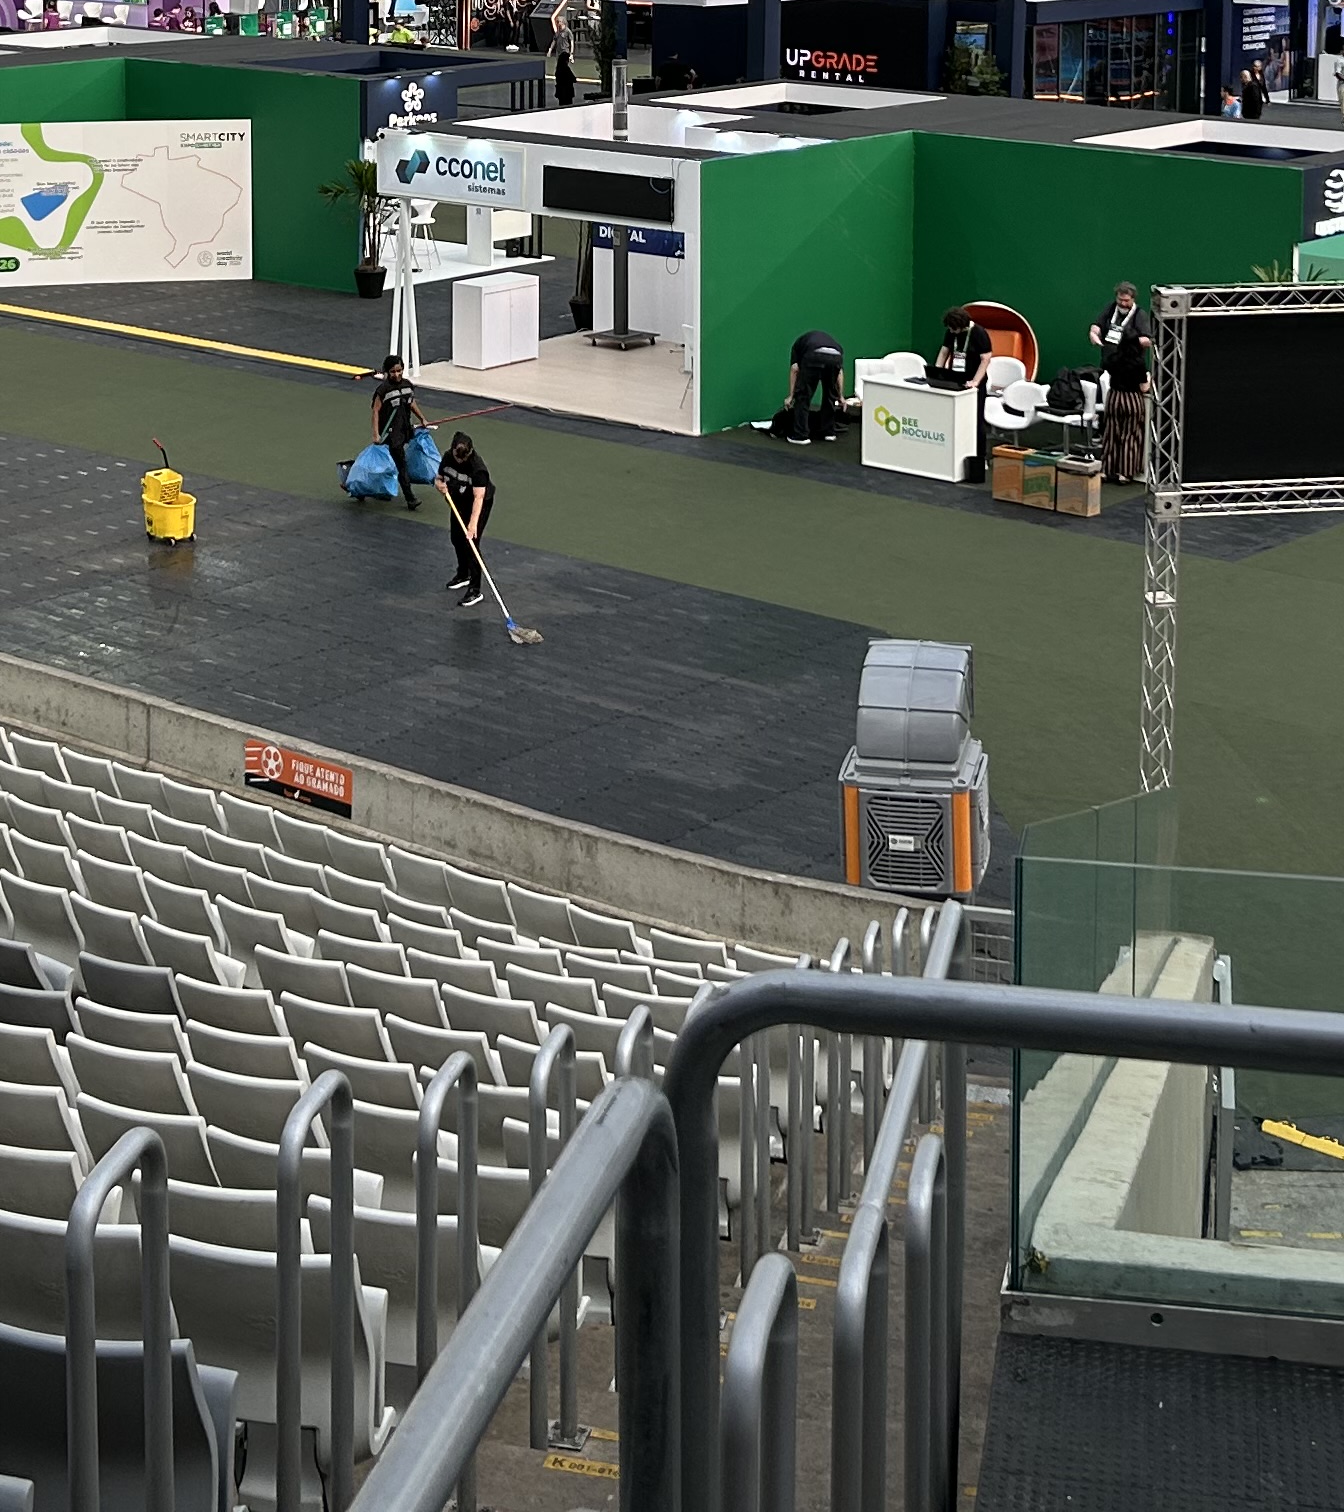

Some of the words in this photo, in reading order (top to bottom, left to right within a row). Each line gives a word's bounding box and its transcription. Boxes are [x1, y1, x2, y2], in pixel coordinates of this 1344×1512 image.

[786, 48, 878, 73] UPGRADE
[799, 70, 864, 83] RENTAL
[179, 132, 246, 142] SMARTCITY
[435, 154, 506, 183] cconet
[467, 183, 506, 196] sistemas
[902, 416, 919, 428] BEE
[901, 427, 945, 442] NOCULUS
[291, 759, 314, 775] FIQUE
[316, 764, 345, 785] ATENTO
[293, 774, 305, 785] AO
[306, 776, 345, 797] GRAMADO
